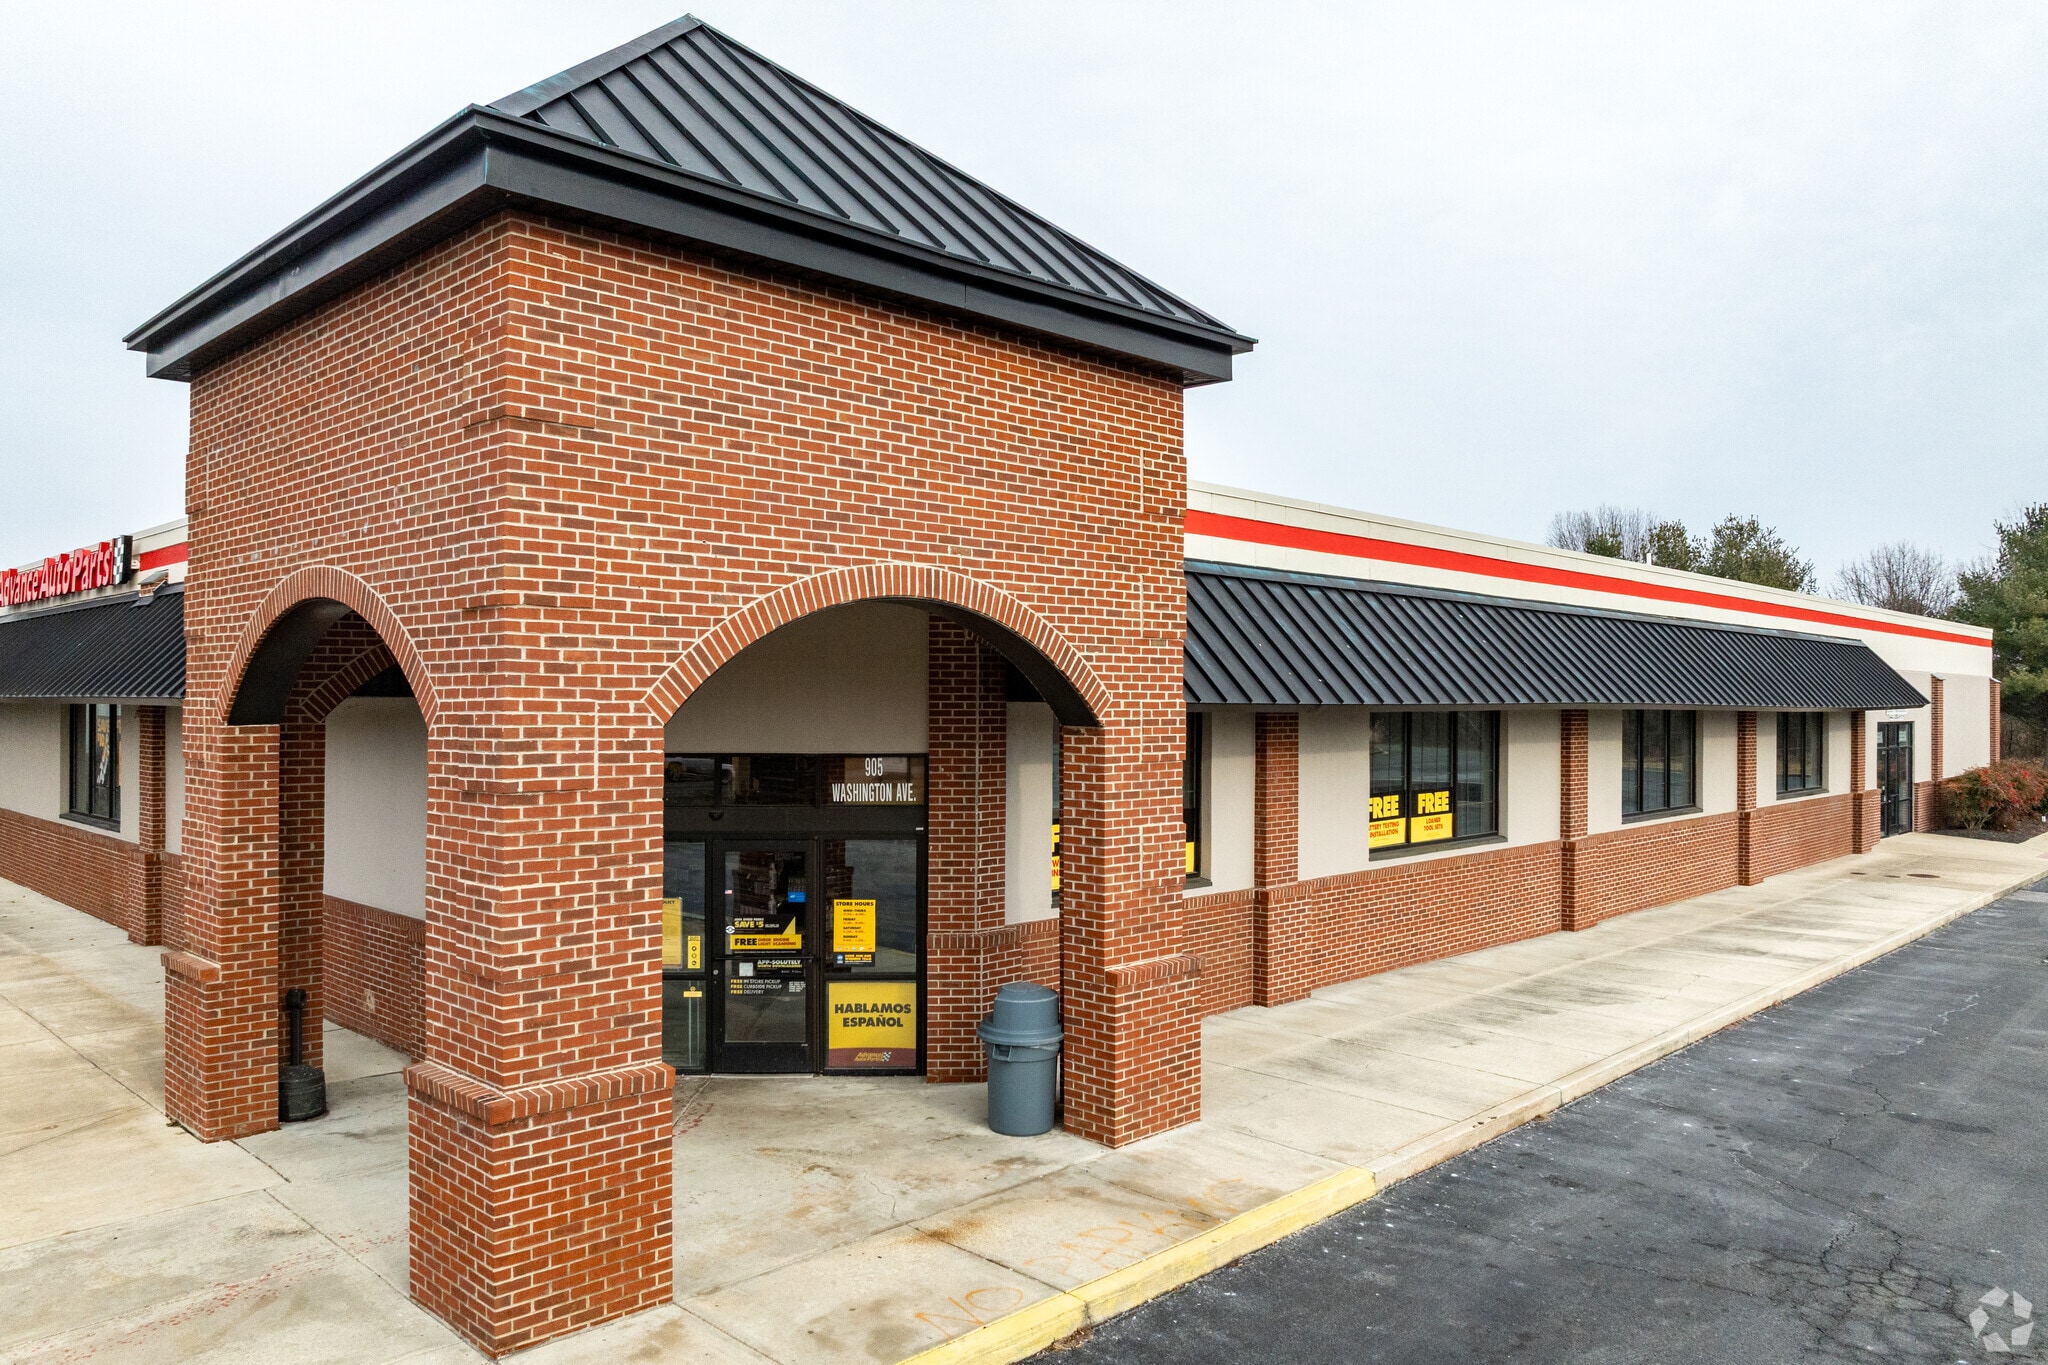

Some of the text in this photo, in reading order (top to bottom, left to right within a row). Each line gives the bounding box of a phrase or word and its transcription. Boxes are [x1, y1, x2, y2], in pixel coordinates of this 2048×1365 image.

[39, 558, 70, 599] Auto
[71, 544, 112, 593] Parts
[865, 757, 883, 776] 905
[832, 783, 916, 802] WASHINGTON AVE.
[1418, 791, 1449, 814] FREE
[735, 938, 757, 946] FREE
[835, 1003, 912, 1014] HABLAMOS
[843, 1014, 903, 1027] ESPAÑOL
[914, 1286, 1024, 1340] NO
